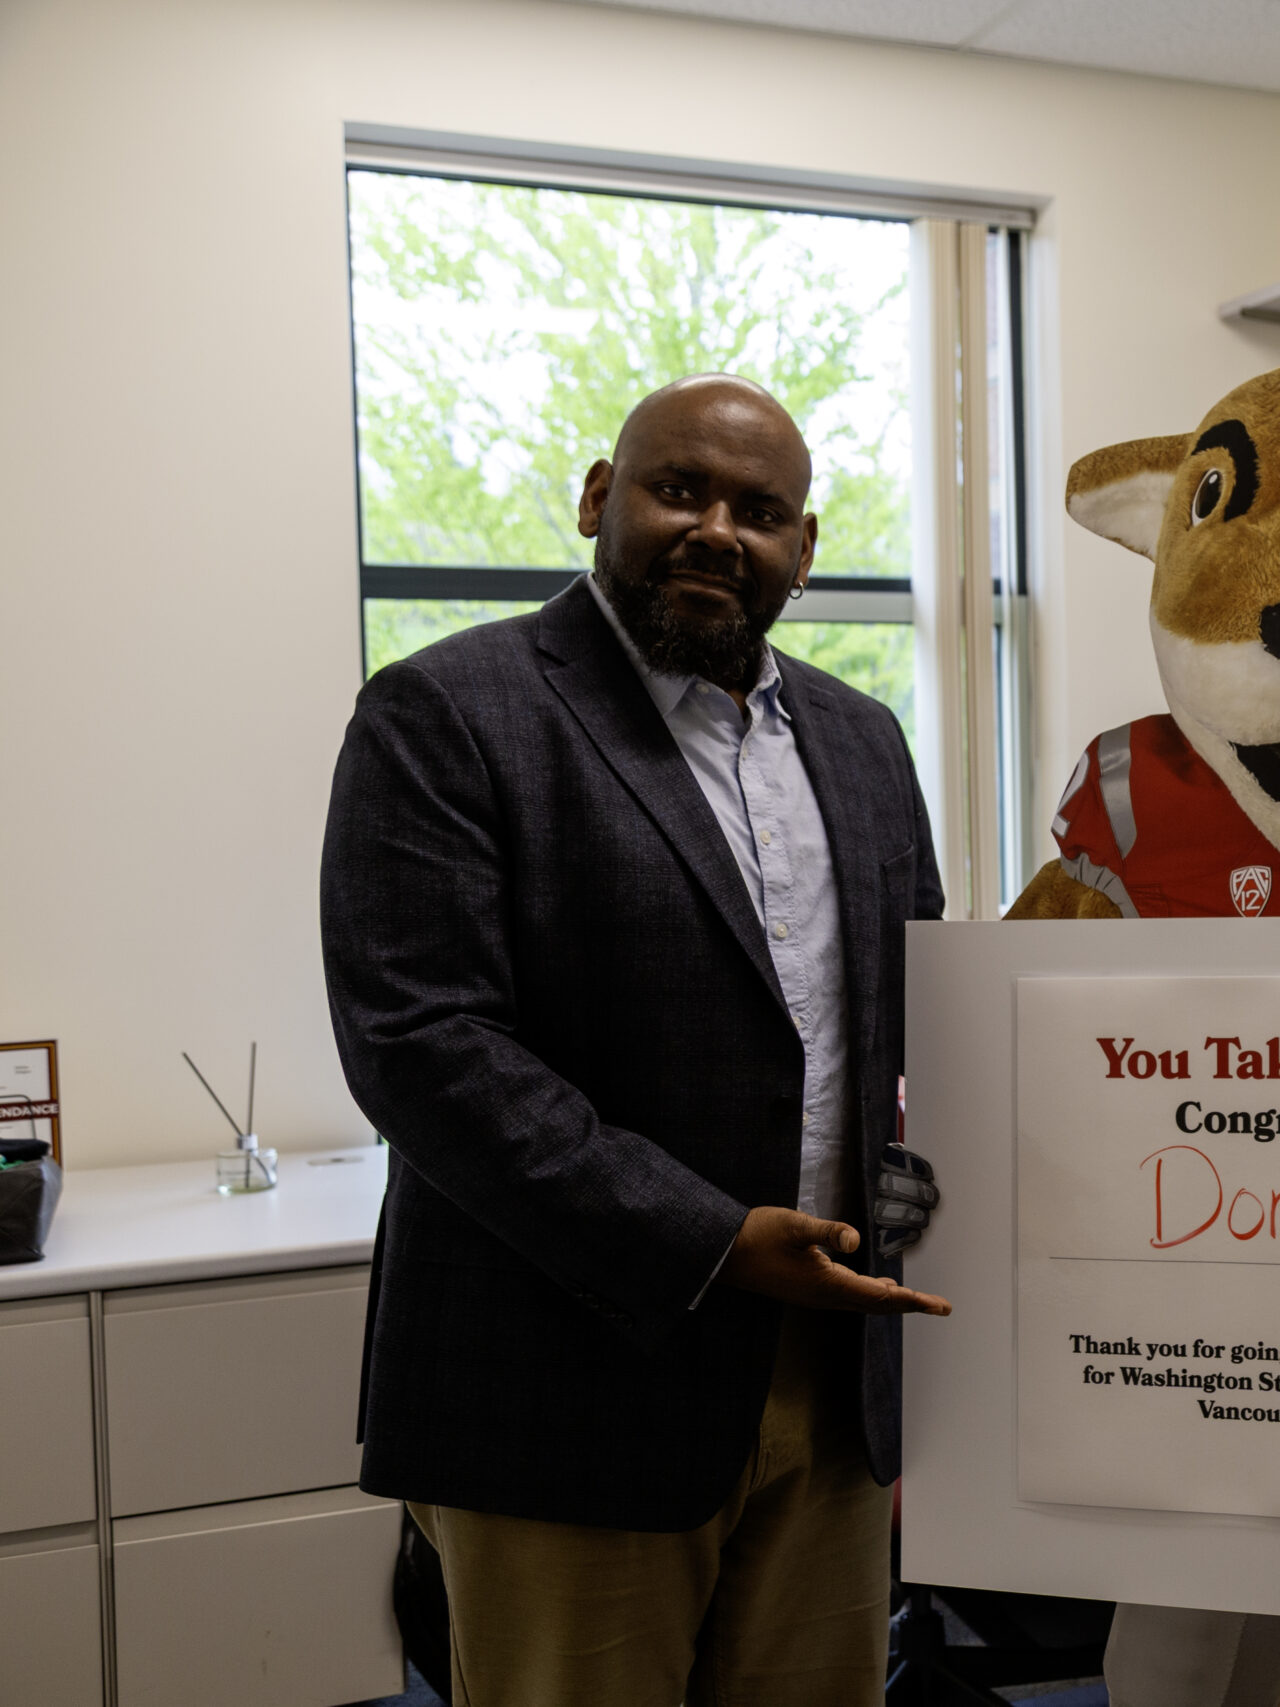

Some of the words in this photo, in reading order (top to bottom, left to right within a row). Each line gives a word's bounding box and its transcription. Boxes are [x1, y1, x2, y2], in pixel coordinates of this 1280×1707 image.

[1233, 867, 1270, 901] PAC
[1240, 890, 1261, 912] 12
[1095, 1036, 1192, 1081] You
[1068, 1333, 1143, 1360] Thank
[1145, 1341, 1188, 1362] you
[1191, 1338, 1227, 1360] for
[1082, 1364, 1117, 1386] for
[1118, 1366, 1254, 1394] Washington
